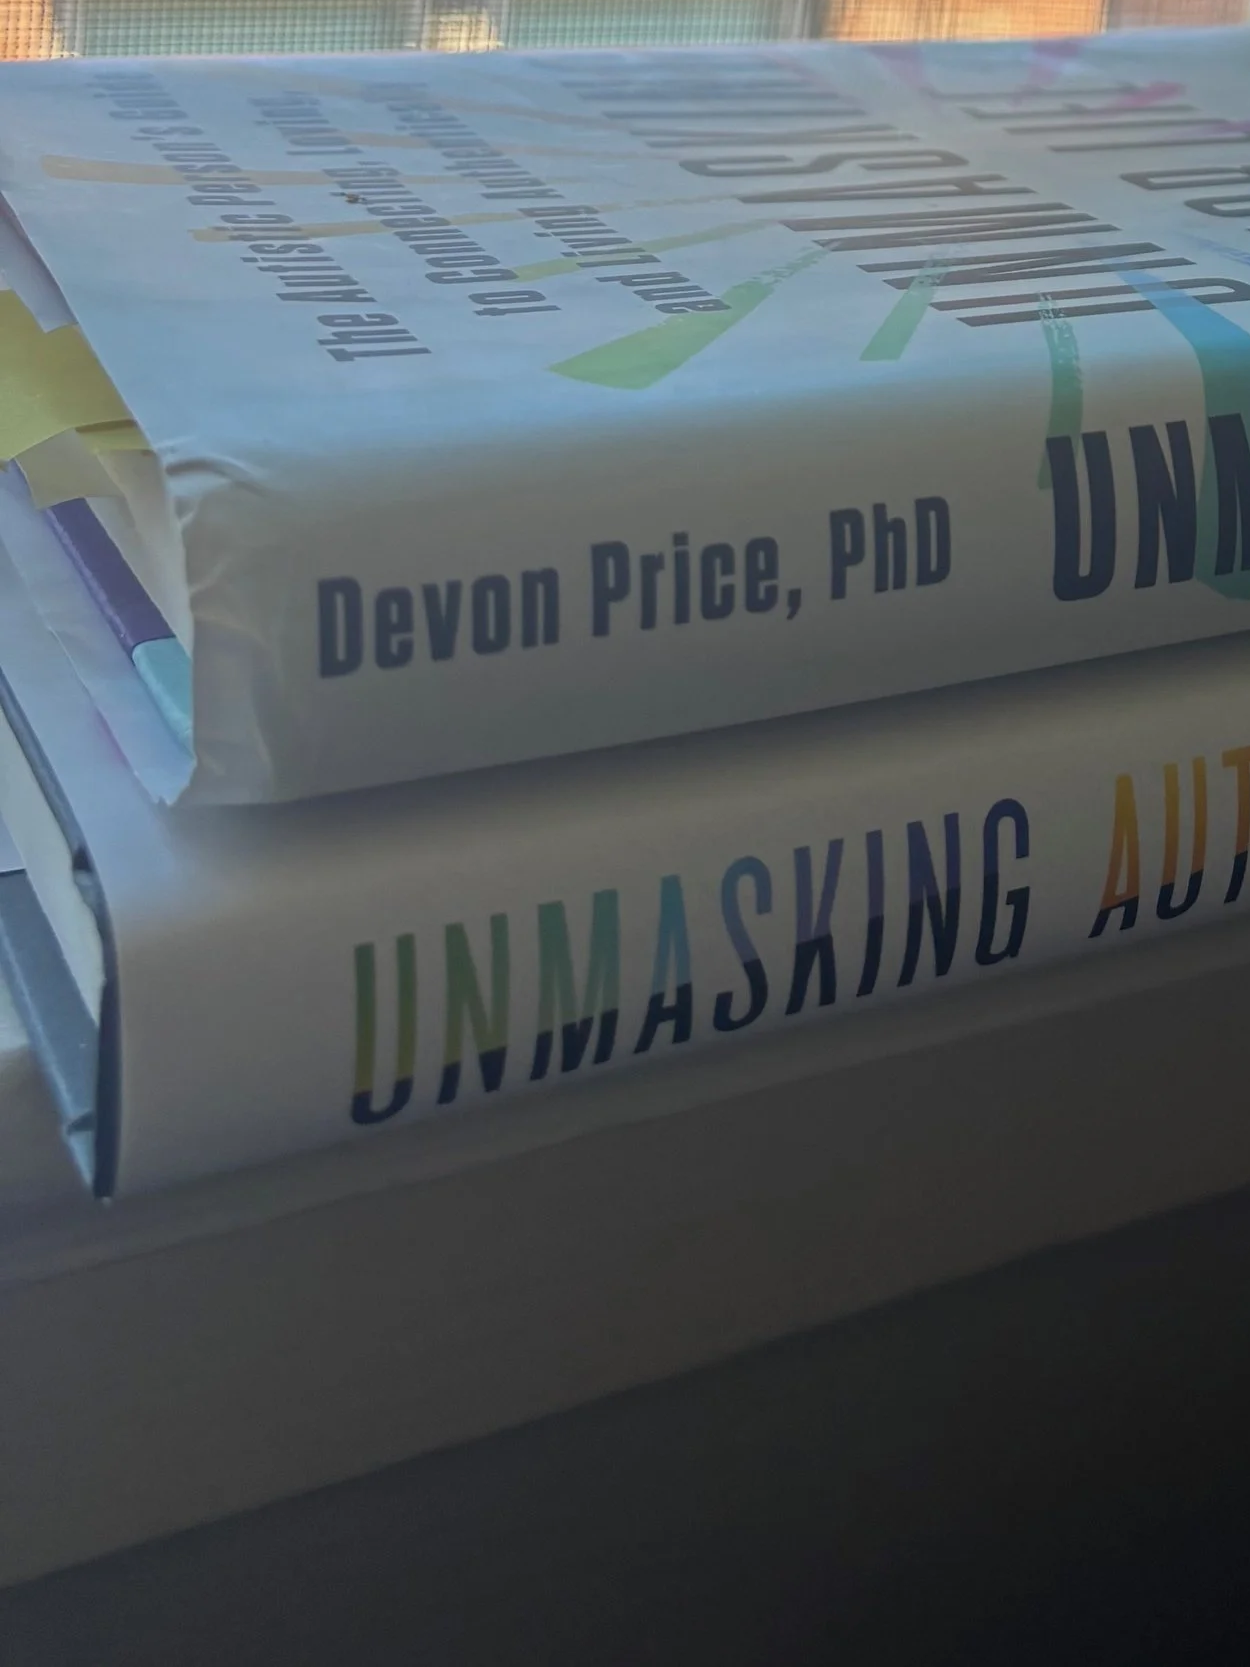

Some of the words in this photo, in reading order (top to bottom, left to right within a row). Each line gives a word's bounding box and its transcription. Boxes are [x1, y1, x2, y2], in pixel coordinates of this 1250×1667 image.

[130, 126, 276, 206] Person's
[211, 213, 377, 302] Autistic
[321, 160, 519, 285] Connecting,
[516, 205, 662, 268] Living
[467, 290, 562, 317] to
[595, 271, 731, 314] and
[317, 313, 432, 362] The
[317, 565, 560, 679] Devon
[589, 531, 803, 639] Price,
[829, 495, 952, 601] PhD
[349, 798, 1031, 1127] UNMASKING
